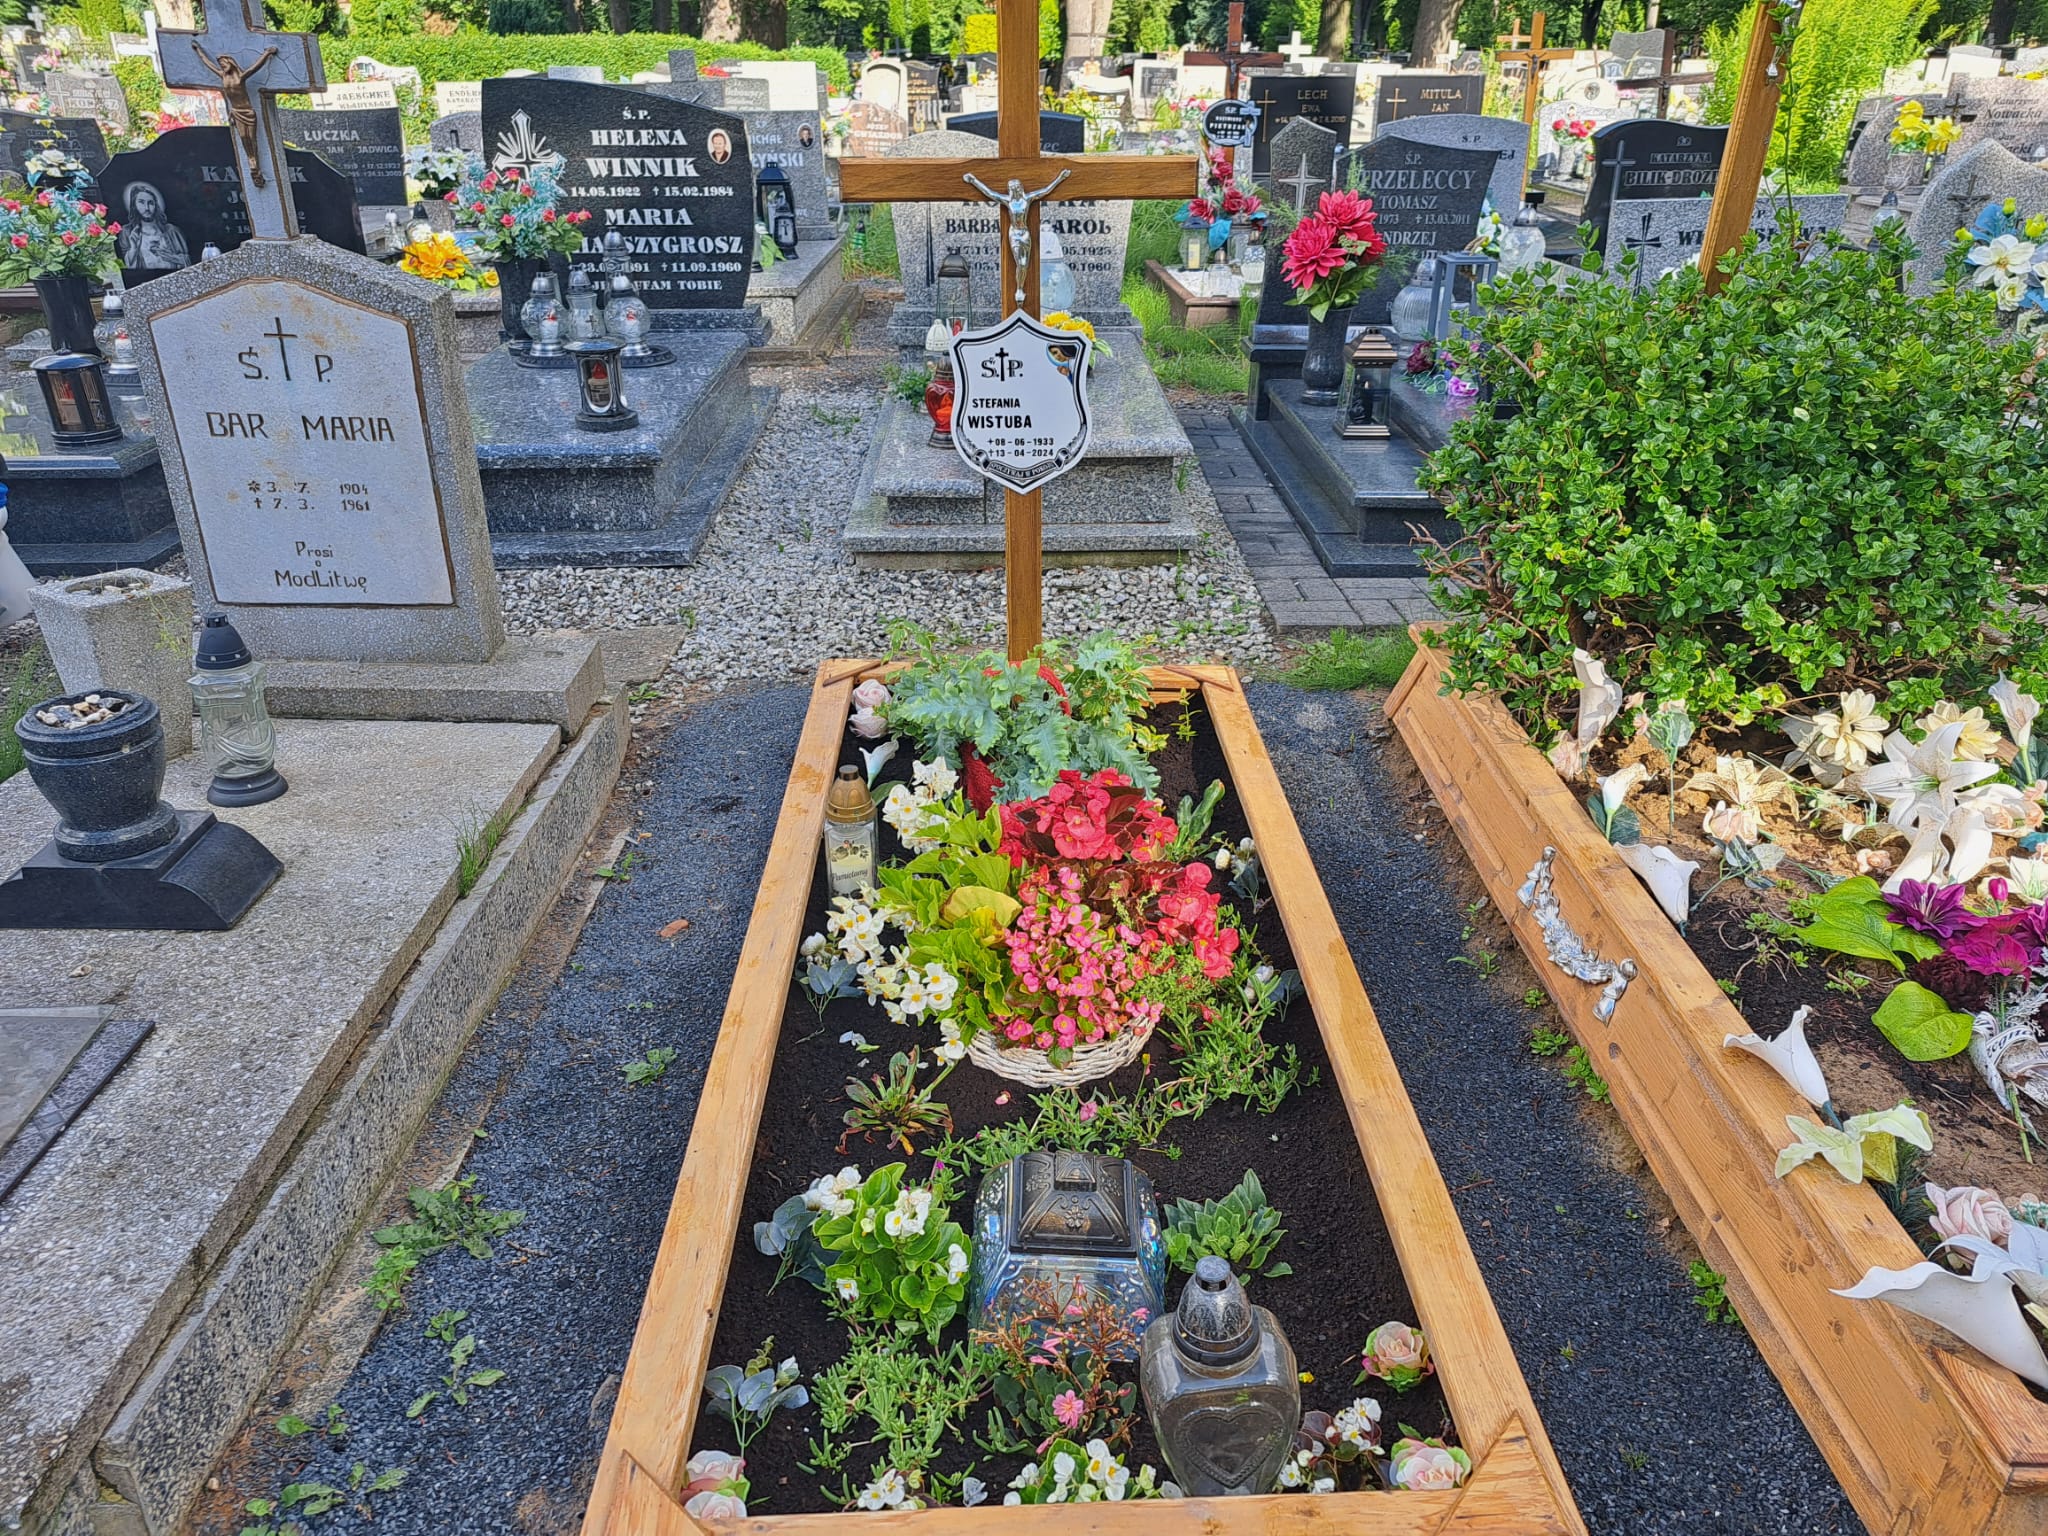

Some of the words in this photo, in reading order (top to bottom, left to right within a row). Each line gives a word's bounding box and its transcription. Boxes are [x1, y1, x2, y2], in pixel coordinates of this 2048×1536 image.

[1297, 90, 1328, 100] LECH
[1420, 89, 1462, 100] MITULA
[1302, 104, 1320, 113] EWA
[1431, 103, 1449, 112] JAN
[303, 130, 360, 142] ŁUCZKA
[590, 129, 689, 147] HELENA
[752, 133, 783, 144] ICHAŁ
[1650, 152, 1712, 164] KATARZYNA
[585, 157, 700, 178] WINNIK
[570, 186, 641, 197] 14.05.1922
[664, 186, 735, 197] 15.02.1984
[1380, 195, 1438, 210] TOMASZ
[604, 208, 694, 226] MARIA
[1382, 231, 1437, 246] NDRZEJ
[671, 262, 742, 272] 11.09.1960
[677, 280, 722, 290] TOBIE
[972, 398, 1021, 409] STEFANIA
[206, 412, 269, 438] BAR
[301, 415, 396, 442] MARIA
[967, 415, 1032, 429] WISTUBA
[339, 484, 369, 496] 1904
[341, 500, 370, 512] 1961
[295, 541, 334, 558] Prosi
